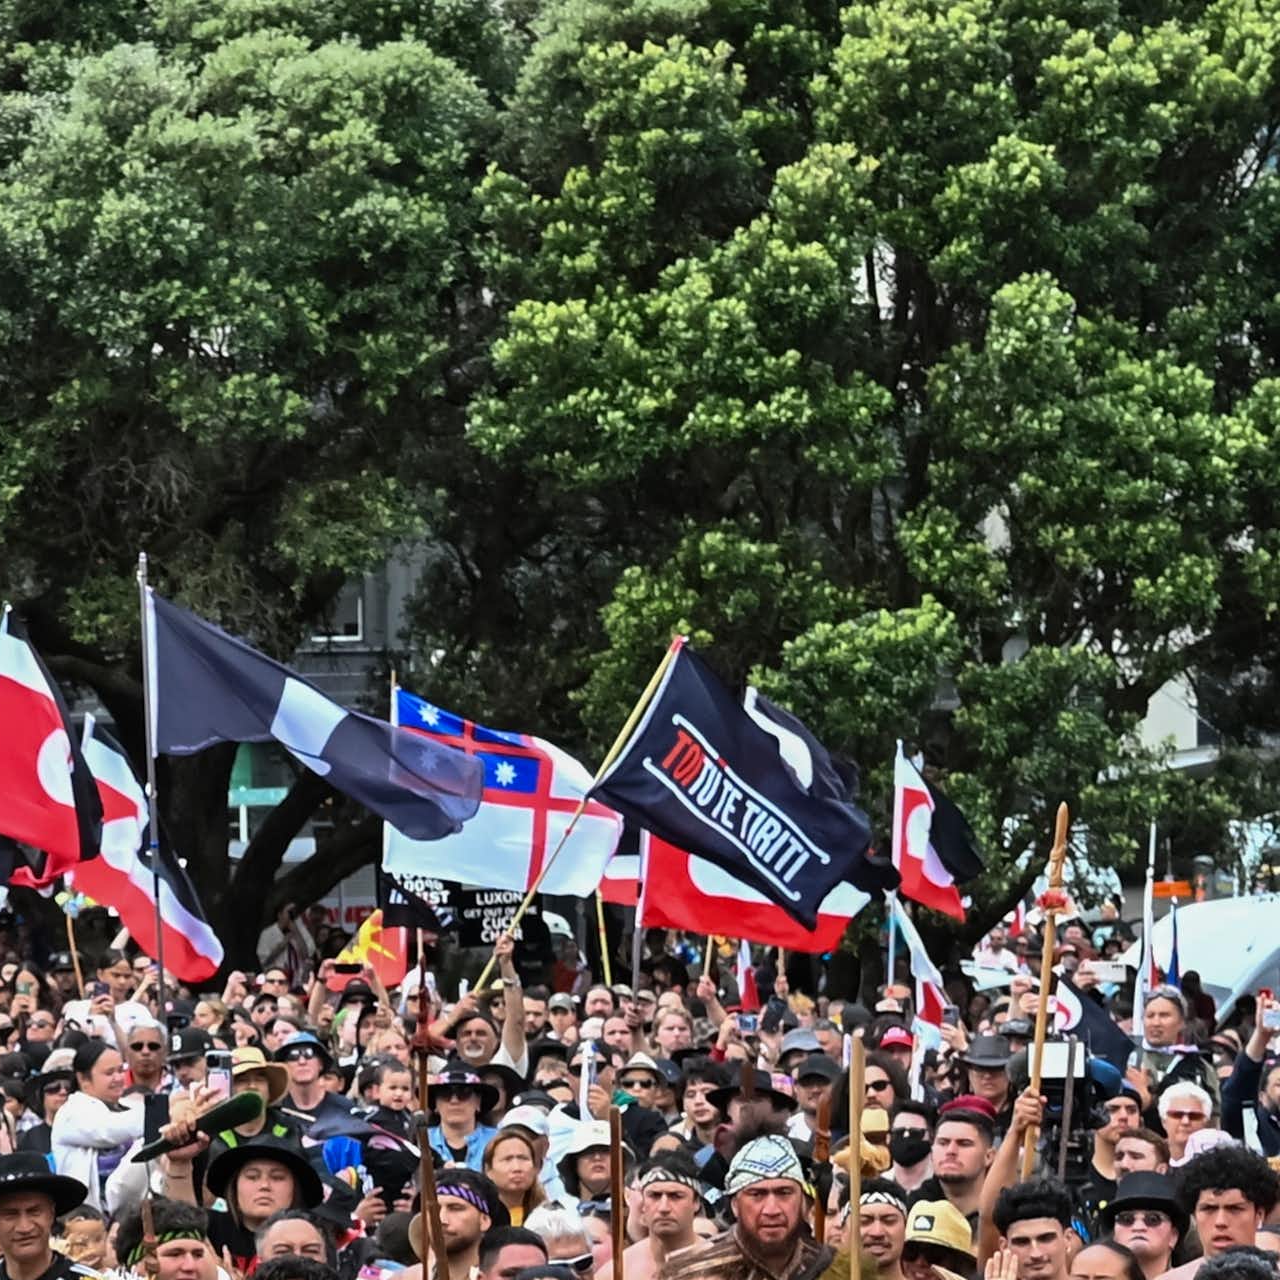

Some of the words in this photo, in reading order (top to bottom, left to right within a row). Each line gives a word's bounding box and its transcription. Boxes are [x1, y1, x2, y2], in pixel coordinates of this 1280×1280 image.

[711, 778, 743, 830] TE
[740, 800, 810, 883] TIRITI
[476, 892, 523, 906] LUXON
[464, 908, 481, 919] GET
[483, 907, 502, 918] OUT
[481, 928, 523, 943] CHR
